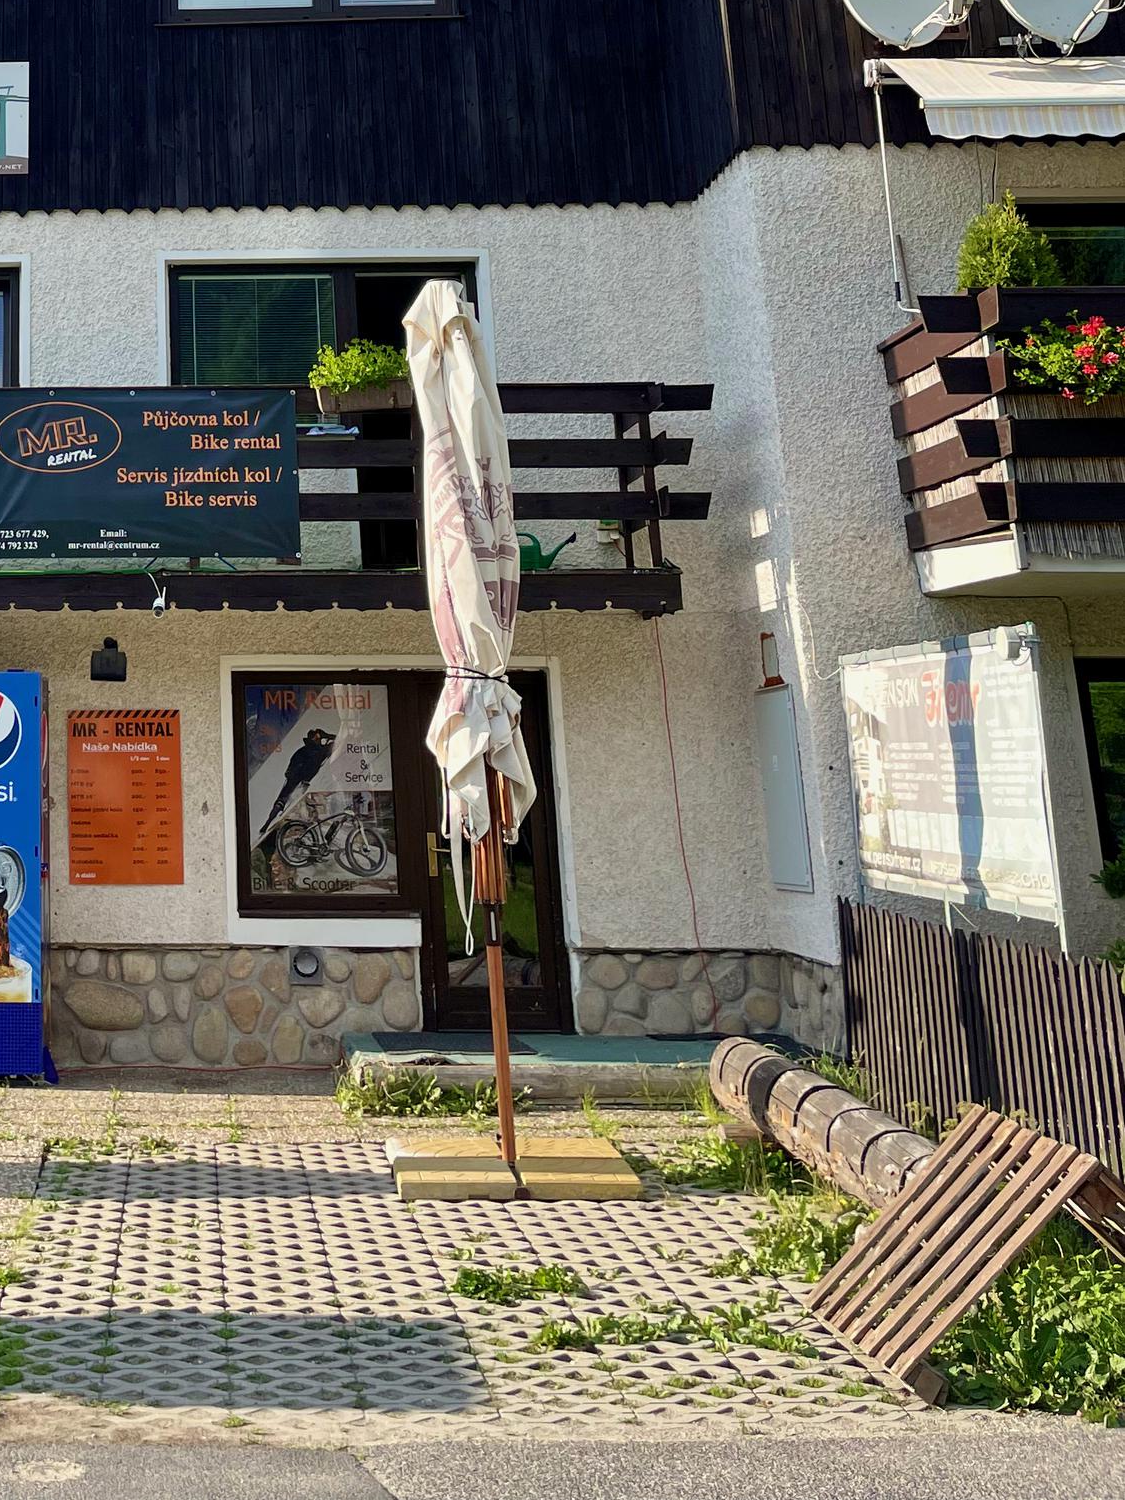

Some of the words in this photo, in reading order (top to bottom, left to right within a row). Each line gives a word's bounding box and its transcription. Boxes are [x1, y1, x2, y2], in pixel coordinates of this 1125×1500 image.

[142, 411, 218, 430] Půjčovna
[222, 410, 249, 427] kol
[190, 434, 229, 450] Bike
[233, 433, 281, 450] rental
[47, 448, 97, 467] RENTAL
[116, 467, 168, 483] Servis
[171, 467, 240, 487] jízdních
[243, 466, 271, 483] kol
[165, 491, 204, 507] Bike
[208, 490, 257, 507] servis
[0, 530, 14, 538] 723
[16, 529, 31, 538] 677
[100, 529, 128, 538] Email:
[7, 541, 22, 550] 792
[23, 541, 38, 550] 323
[68, 540, 160, 550] mr-rental@centrum.cz
[263, 690, 297, 710] MR
[306, 690, 372, 710] Rental
[72, 722, 97, 737] MR
[115, 721, 174, 737] RENTAL
[82, 742, 110, 752] Naše
[346, 743, 380, 754] Rental
[360, 759, 369, 770] &
[345, 772, 384, 784] Service
[302, 877, 356, 891] Scooter
